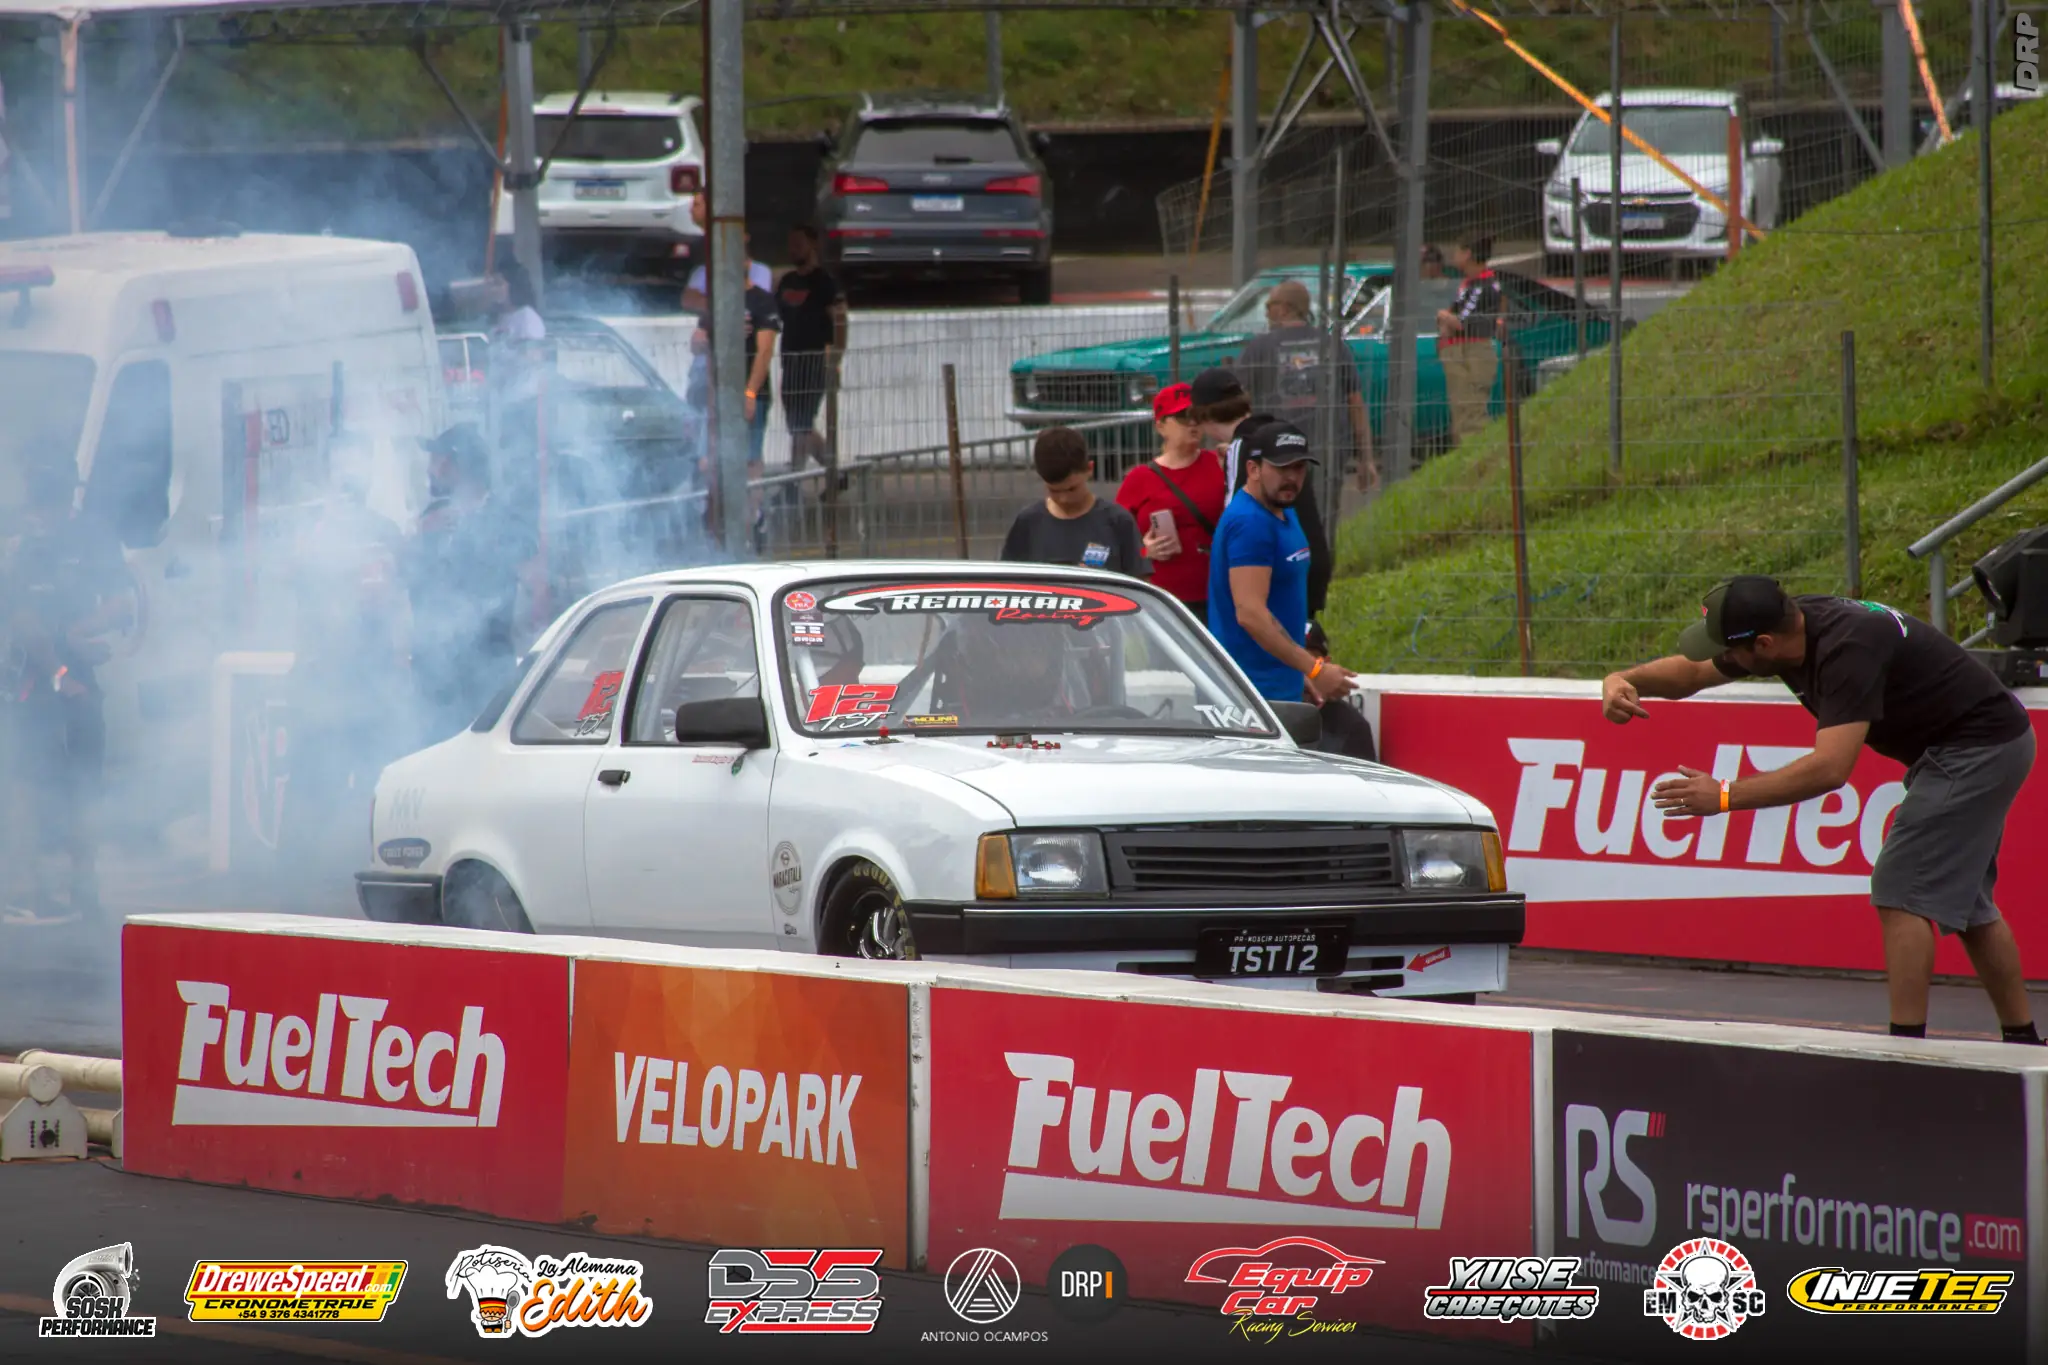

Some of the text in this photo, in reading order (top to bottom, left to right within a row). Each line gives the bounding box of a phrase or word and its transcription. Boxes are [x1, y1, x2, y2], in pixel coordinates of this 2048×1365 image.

[891, 593, 1083, 611] REMOKAR
[996, 607, 1101, 626] Racing
[805, 684, 898, 724] 12
[820, 711, 895, 731] TST
[1507, 737, 1907, 867] FuelTec
[176, 980, 506, 1128] FuelTech
[615, 1051, 861, 1170] VELOPARK
[1004, 1052, 1452, 1230] FuelTech
[1565, 1103, 1658, 1247] RS
